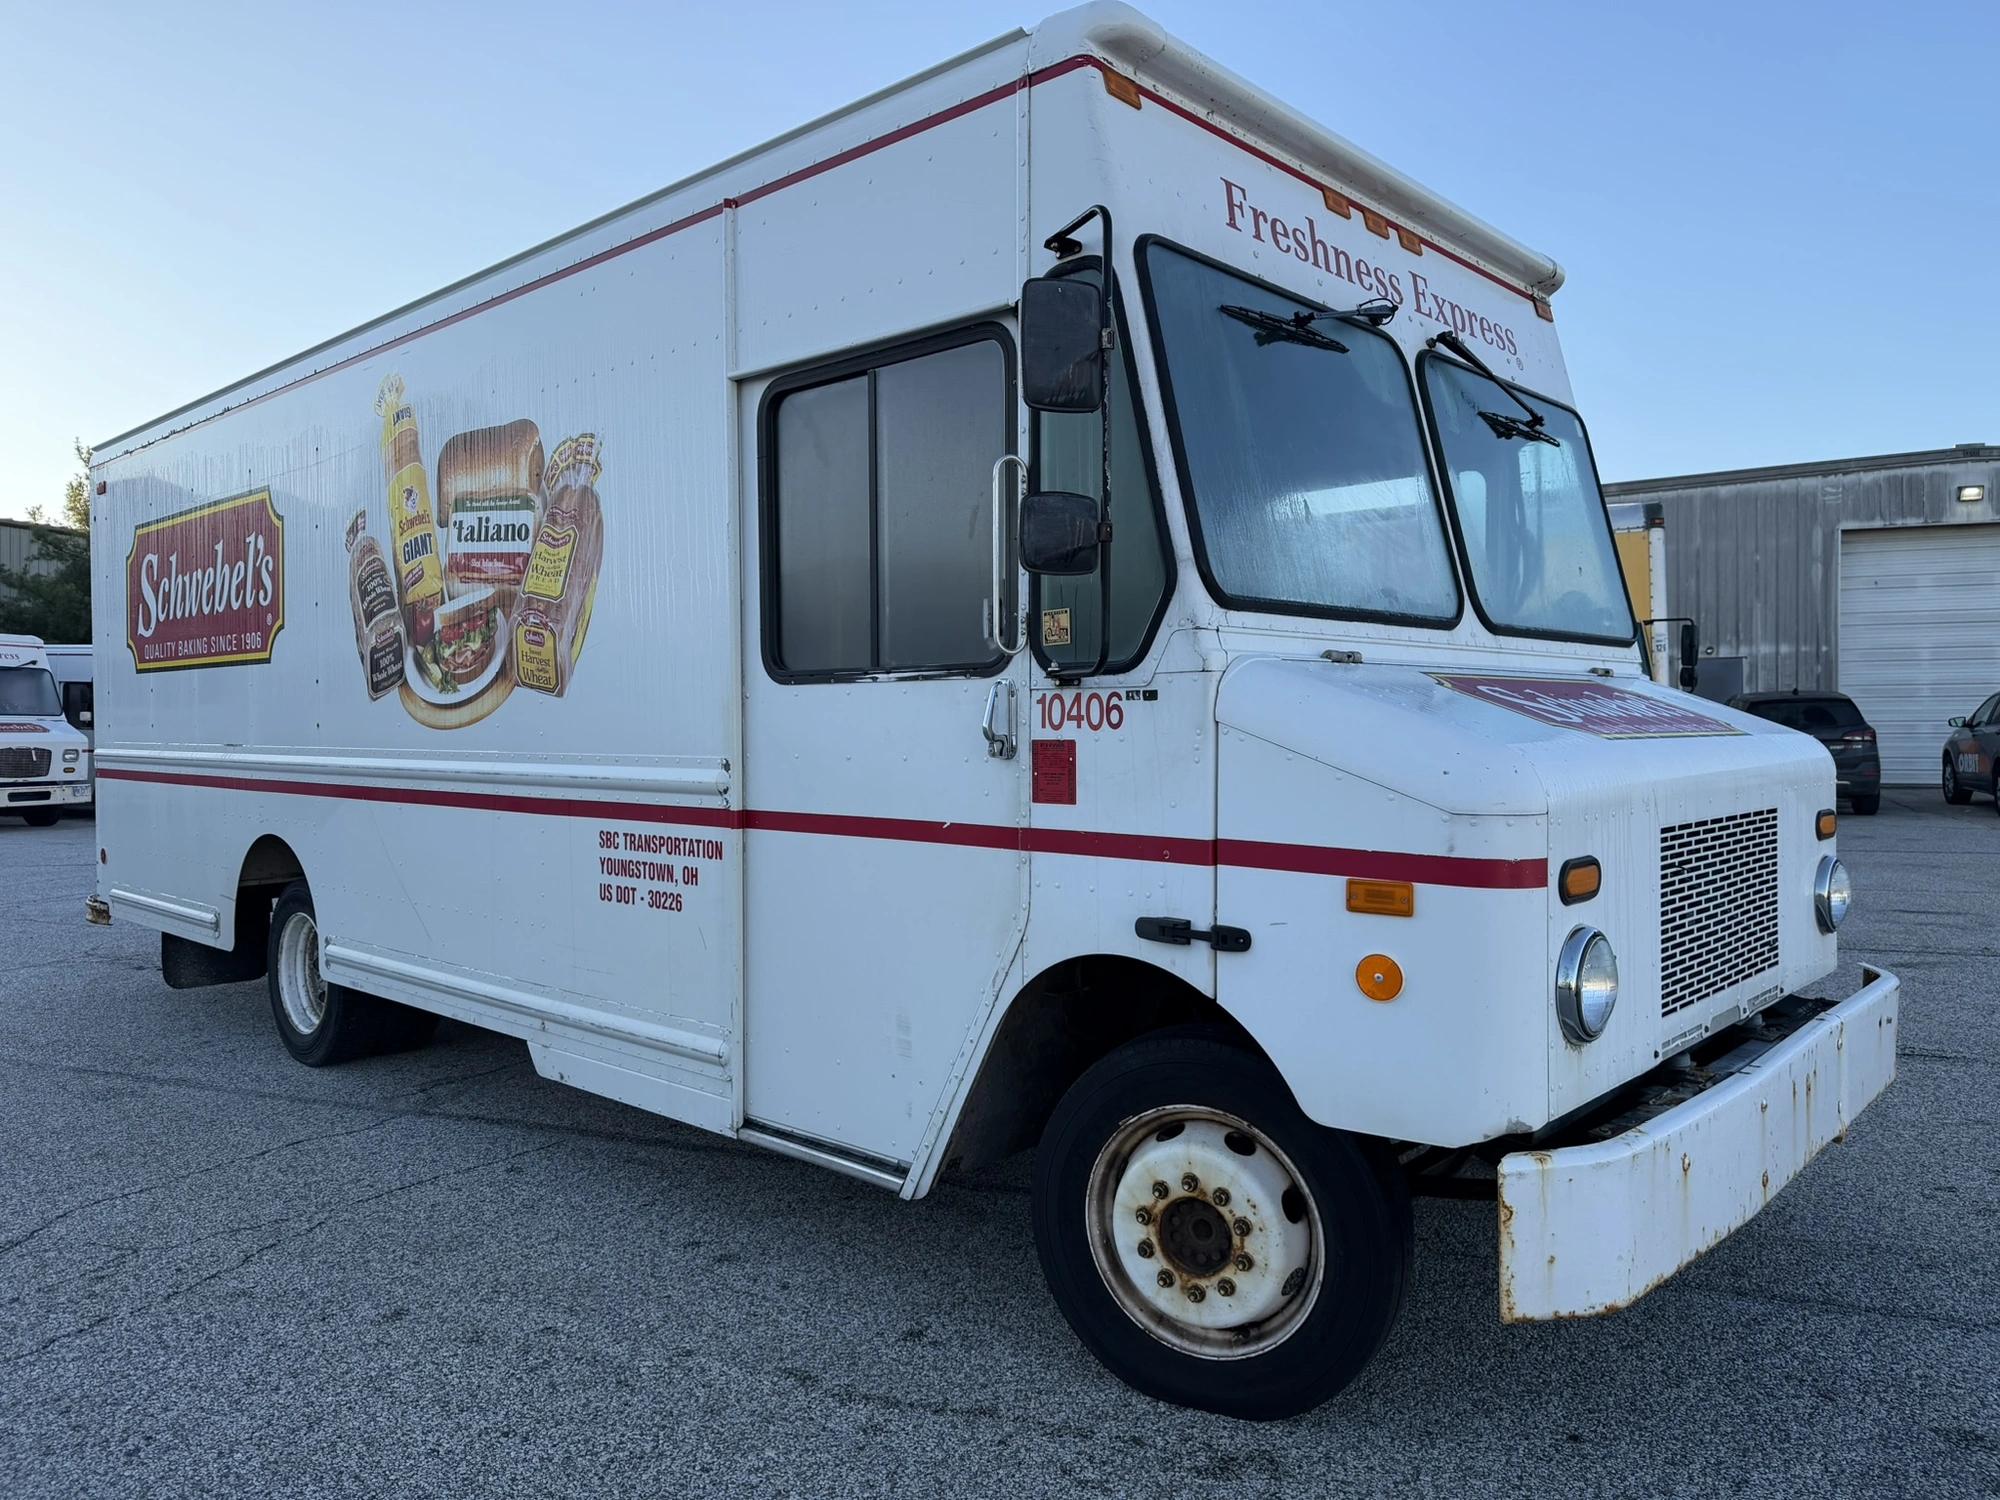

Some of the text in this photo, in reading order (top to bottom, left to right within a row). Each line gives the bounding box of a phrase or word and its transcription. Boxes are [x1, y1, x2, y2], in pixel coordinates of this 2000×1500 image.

[1220, 177, 1518, 356] Freshness Express
[399, 509, 431, 537] Schwebel's
[403, 532, 434, 565] GIANT
[534, 551, 567, 566] Harvest
[137, 531, 273, 637] Schwebel's
[531, 563, 563, 578] Wheat
[144, 631, 262, 660] QUALITY BAKING SINCE 1906
[521, 650, 551, 668] Harvest
[380, 652, 395, 669] 100%
[522, 666, 552, 686] Wheat
[1036, 691, 1124, 731] 10406
[1958, 753, 1979, 773] ORBIT
[599, 829, 723, 860] SBC TRANSPORTATION
[599, 856, 698, 887] YOUNGSTOWN, OH
[599, 883, 613, 902] US
[616, 885, 637, 906] DOT
[648, 889, 683, 913] 30226
